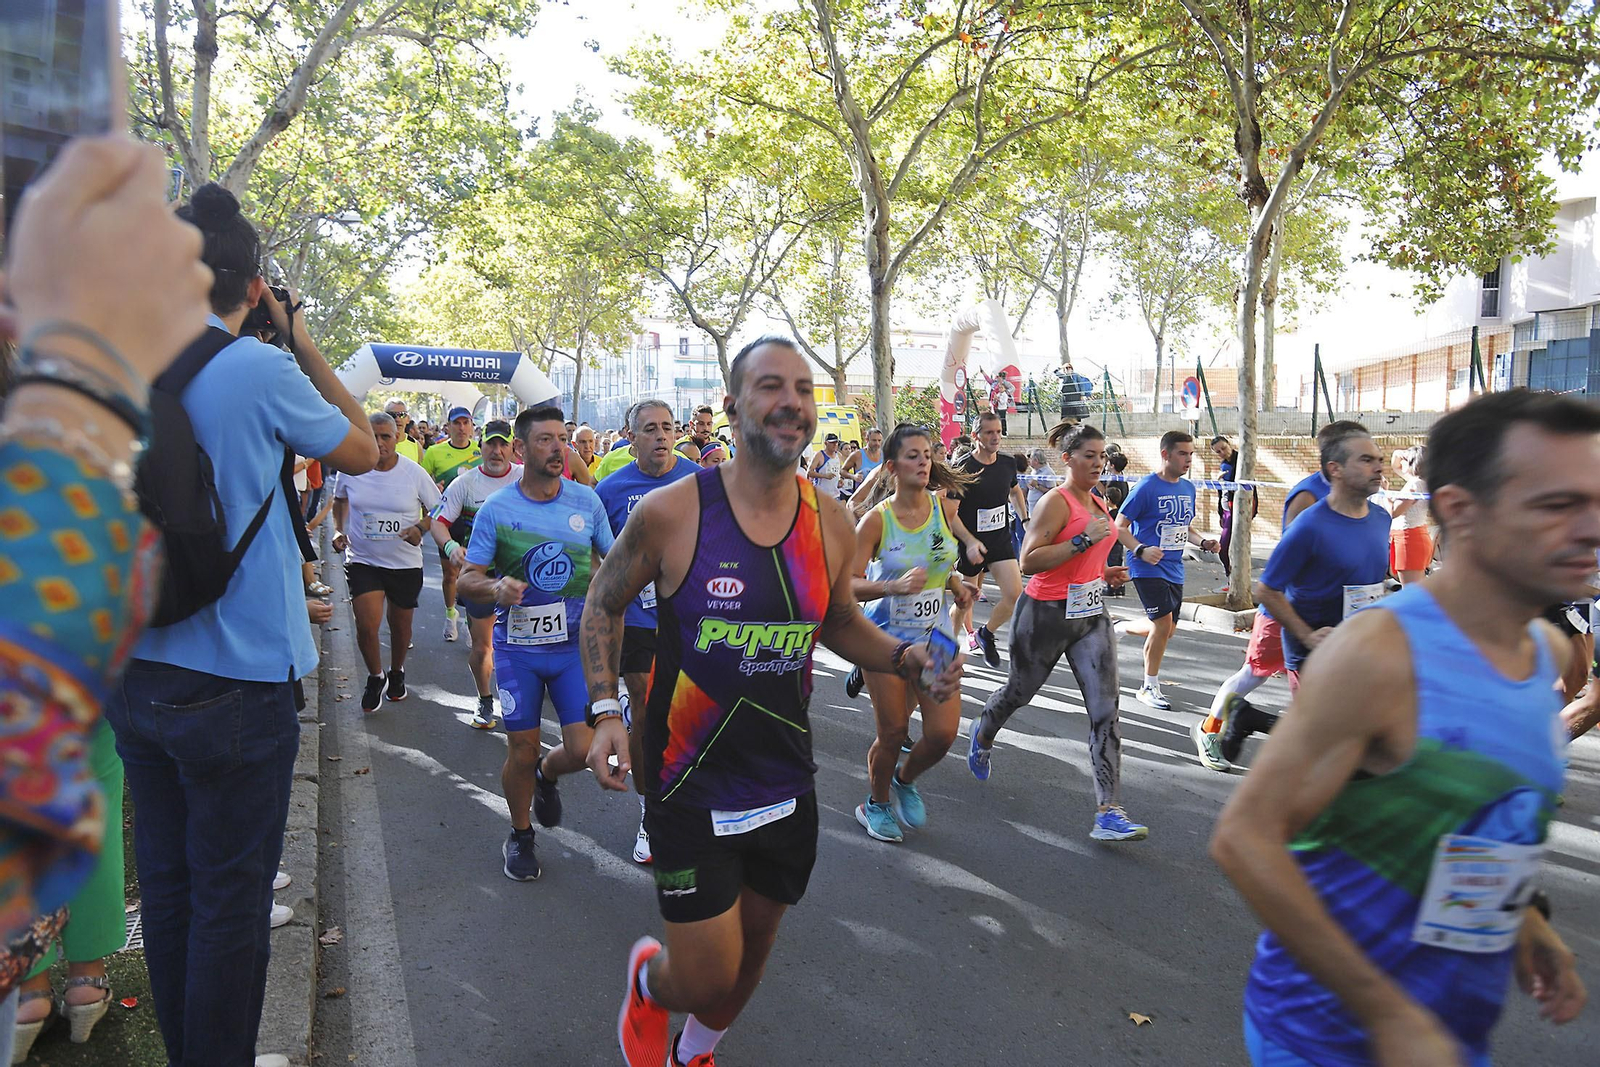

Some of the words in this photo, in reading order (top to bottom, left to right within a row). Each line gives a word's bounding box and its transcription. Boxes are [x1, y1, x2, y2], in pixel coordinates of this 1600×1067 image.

[427, 354, 501, 369] HYUNDAI
[461, 371, 500, 380] SYRLUZ
[990, 511, 1005, 523] 417
[378, 520, 400, 533] 730
[545, 561, 568, 576] JD
[712, 581, 739, 593] KIA
[1087, 588, 1105, 607] 36
[707, 600, 741, 610] VEYSER
[914, 599, 940, 617] 390
[530, 613, 562, 634] 751
